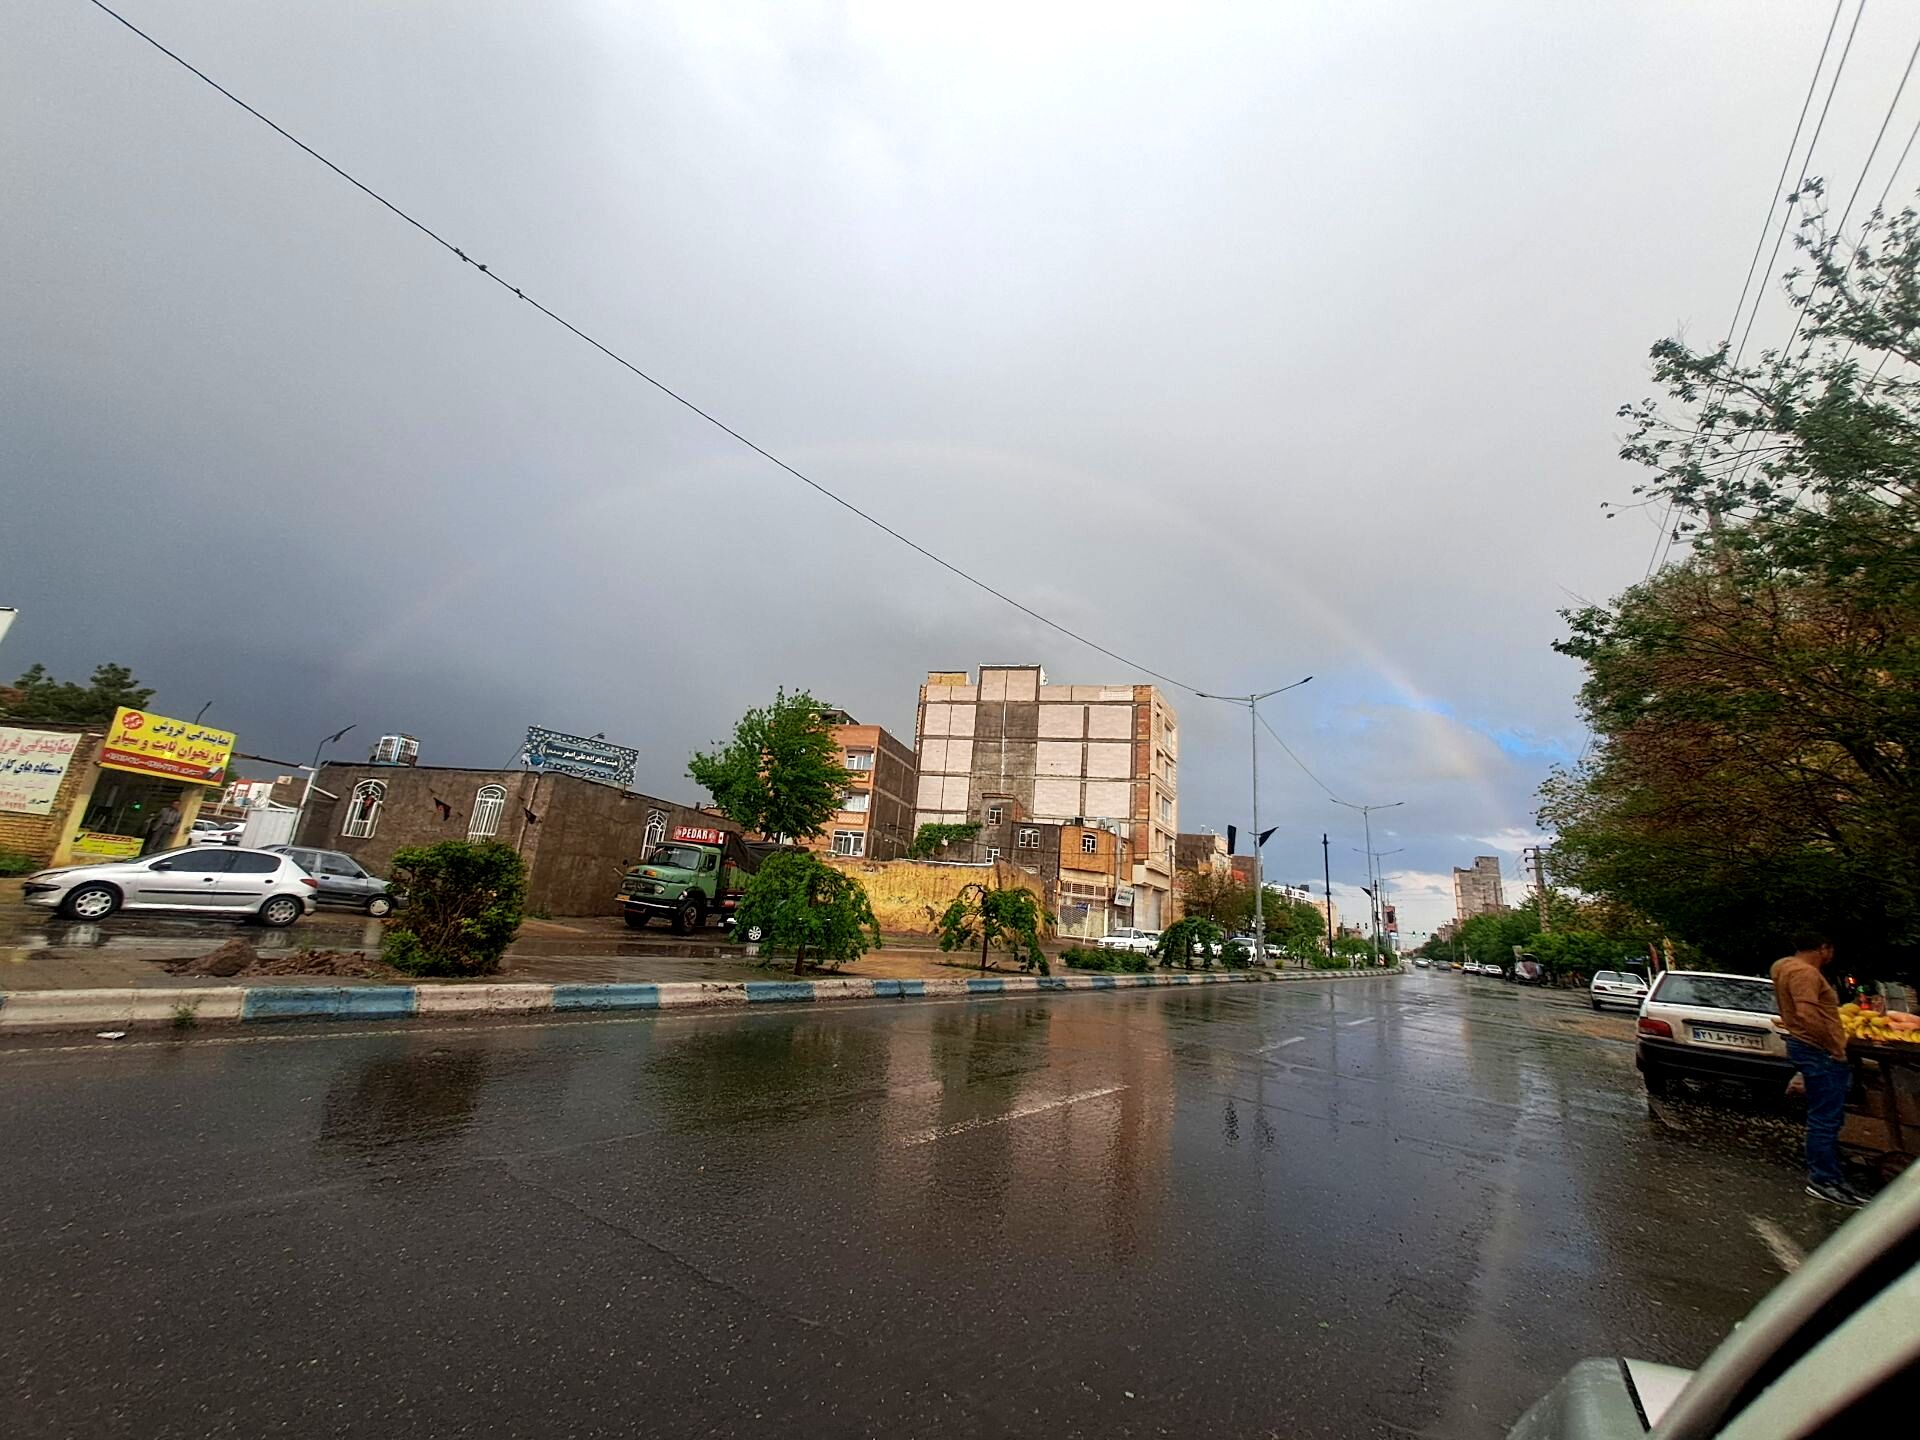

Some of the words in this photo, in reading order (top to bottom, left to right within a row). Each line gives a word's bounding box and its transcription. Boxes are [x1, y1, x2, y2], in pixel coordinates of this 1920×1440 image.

[152, 721, 186, 737] فروش
[111, 731, 139, 746] سیار
[187, 730, 231, 746] نمایندگی
[139, 739, 148, 751] و
[152, 739, 177, 752] ثابت
[13, 760, 33, 774] های
[34, 762, 63, 775] دستگاه
[681, 827, 708, 840] PEDAR
